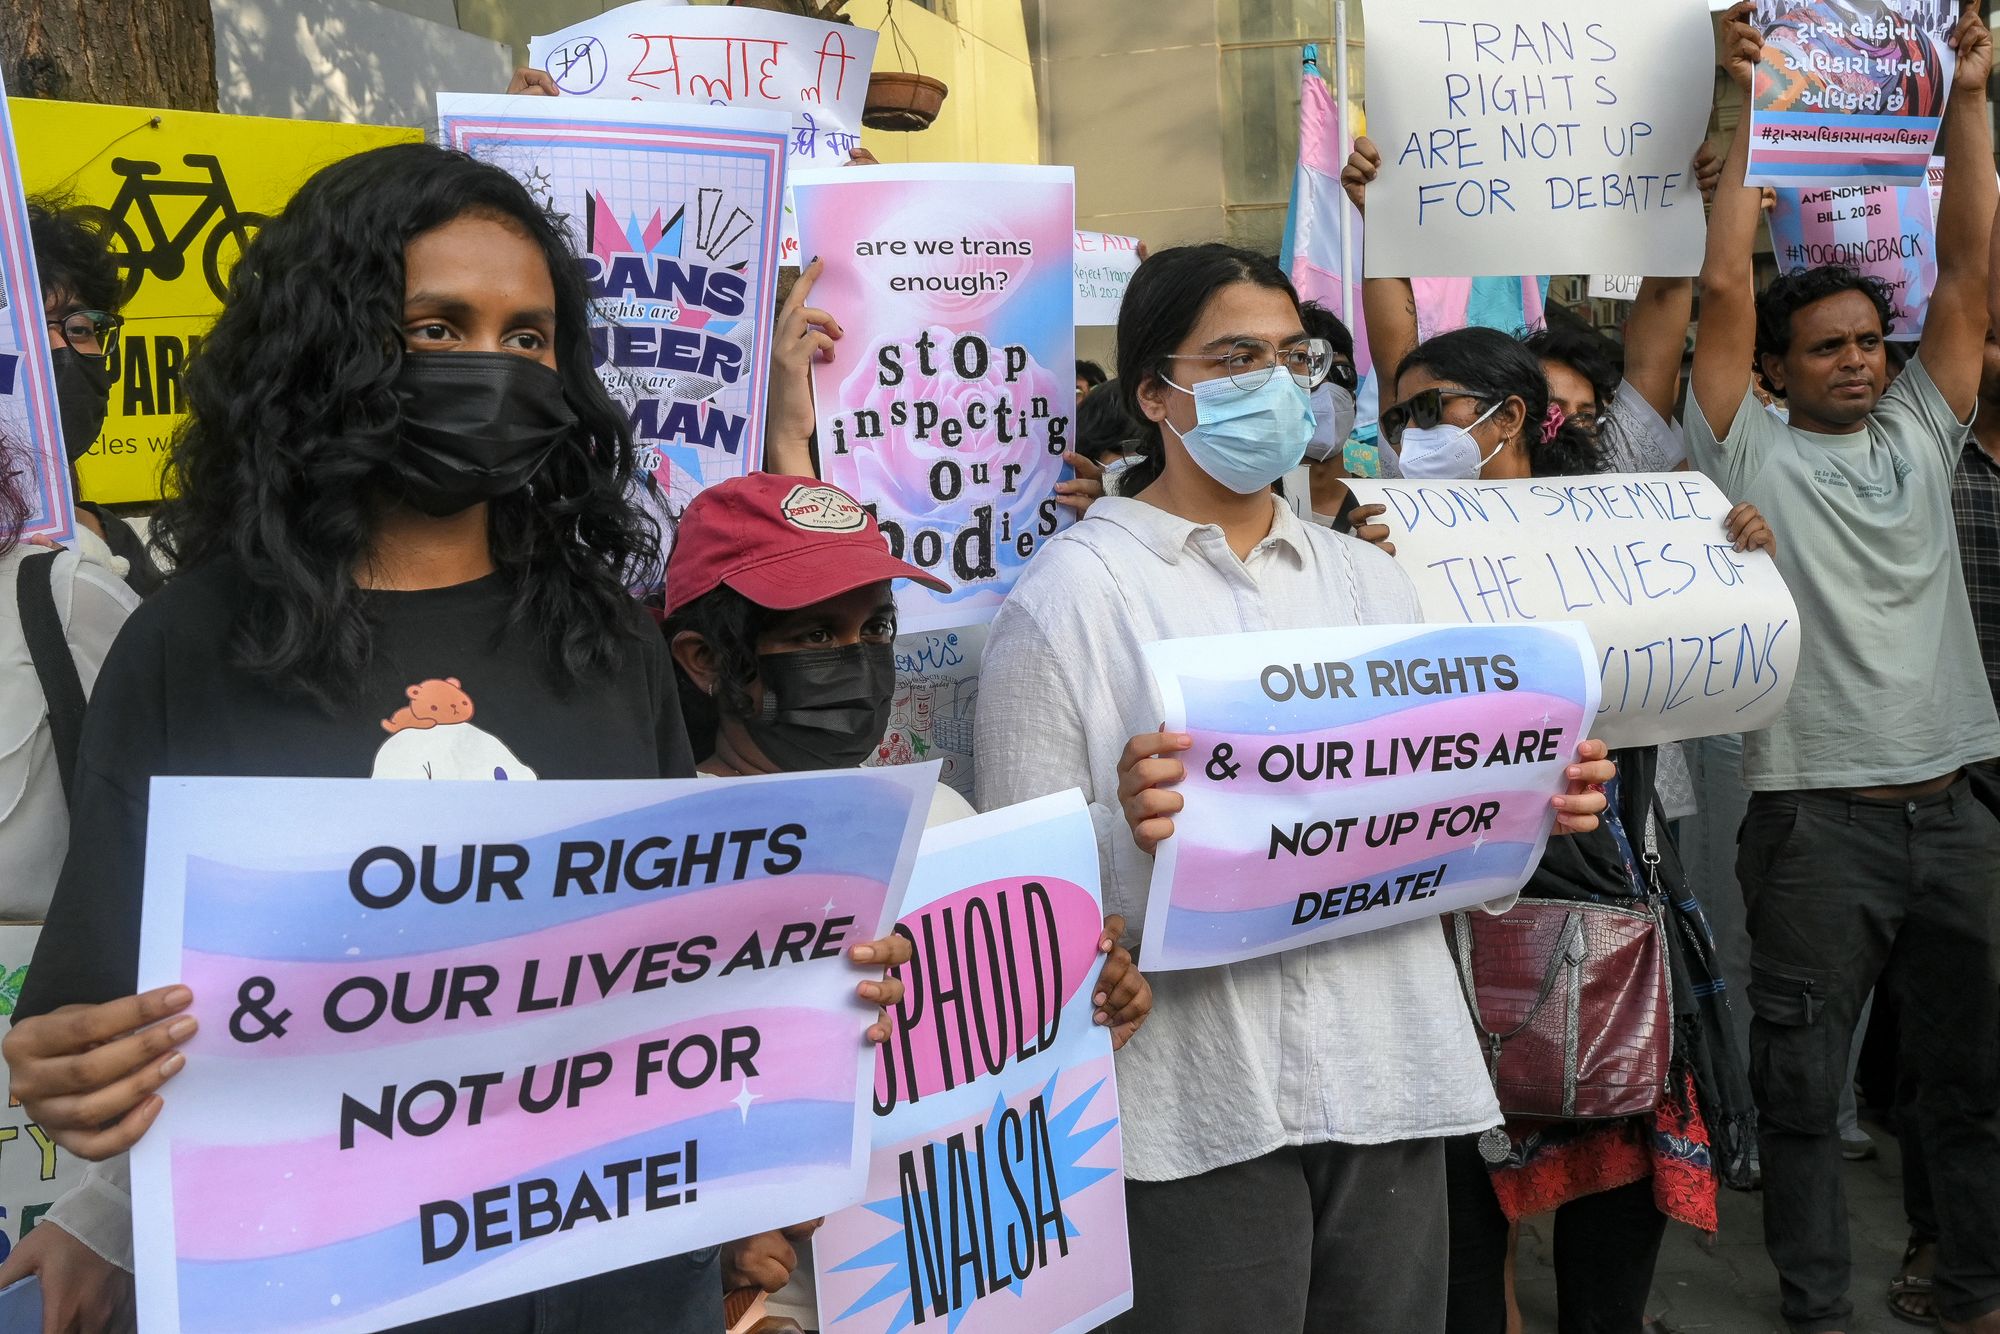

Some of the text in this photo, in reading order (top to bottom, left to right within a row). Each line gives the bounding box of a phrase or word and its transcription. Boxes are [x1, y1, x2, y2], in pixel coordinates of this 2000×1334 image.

[1419, 20, 1616, 65] TRANS
[1876, 58, 1926, 77] માનવ
[1445, 74, 1617, 120] RIGHTS
[1887, 87, 1905, 111] છે
[1399, 122, 1652, 169] ARE NOT UP
[1418, 173, 1682, 226] FOR DEBATE
[1801, 186, 1888, 204] AMENDMENT
[1817, 204, 1882, 223] BILL 2026
[856, 237, 1032, 256] are we trans
[1102, 234, 1137, 252] ALL
[1785, 233, 1923, 265] #NOGOINGBACK
[889, 271, 1008, 296] enough?
[1080, 283, 1097, 298] Bill
[651, 305, 679, 321] are
[601, 372, 677, 389] ights are
[832, 396, 1069, 456] inspecting
[789, 504, 819, 516] ESTD
[1382, 481, 1712, 532] DON'T SYSTEMIZE
[1427, 541, 1745, 623] THE LIVES OF
[1259, 653, 1520, 702] OUR RIGHTS
[1204, 727, 1564, 783] & OUR LIVES ARE
[1267, 800, 1501, 860] NOT UP FOR
[347, 822, 808, 910] OUR RIGHTS
[1291, 862, 1448, 926] DEBATE!
[228, 914, 857, 1043] & OUR LIVES ARE
[339, 1025, 761, 1151] NOT UP FOR
[418, 1138, 699, 1267] DEBATE!
[899, 1093, 1070, 1325] NALSA
